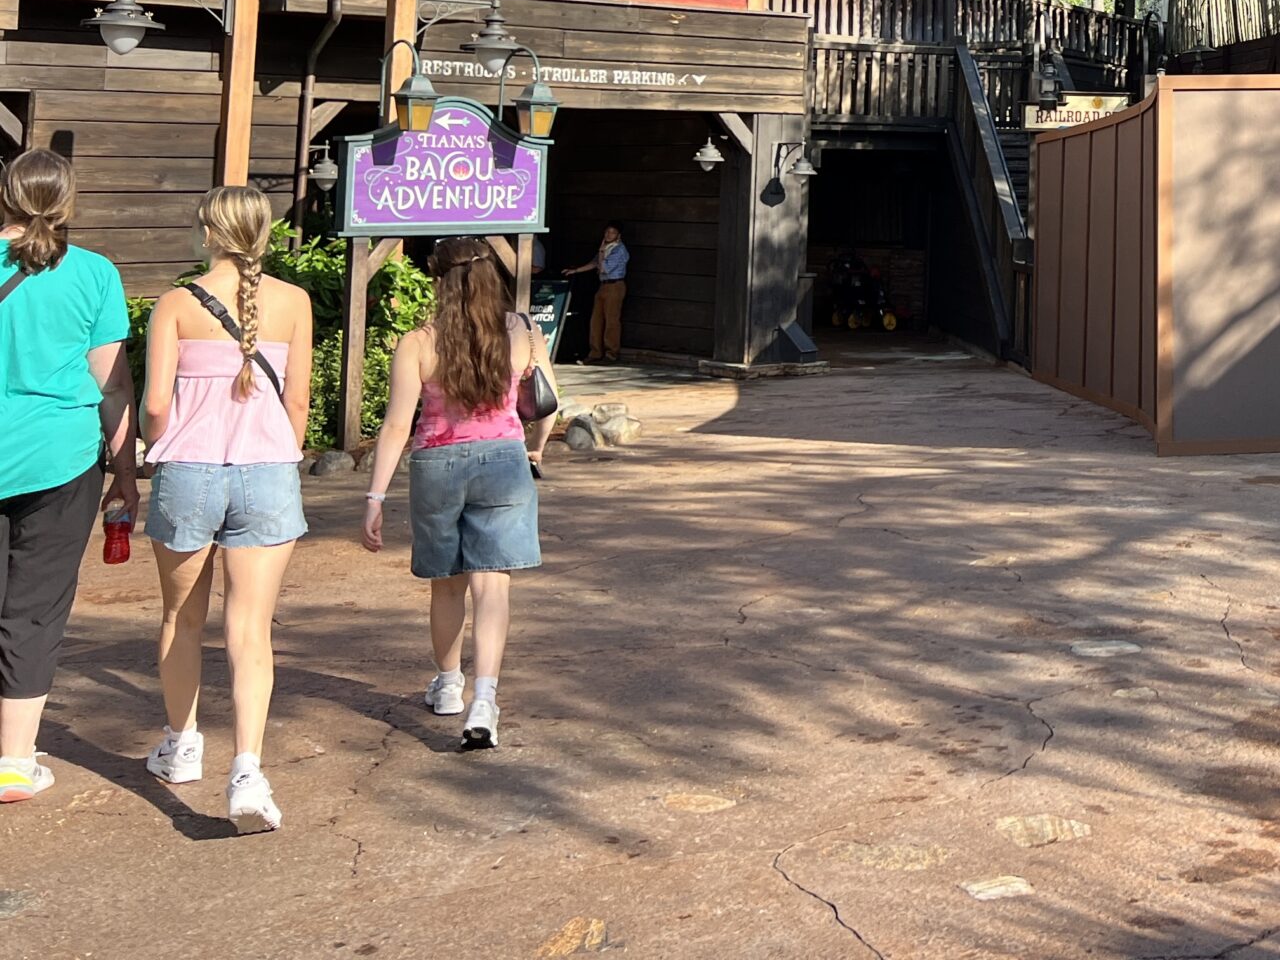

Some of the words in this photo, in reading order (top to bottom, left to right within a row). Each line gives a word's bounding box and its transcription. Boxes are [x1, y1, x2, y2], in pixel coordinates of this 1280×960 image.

[422, 59, 516, 79] RESTROS
[612, 70, 675, 85] PARKING
[1035, 109, 1100, 124] RAILROAD
[417, 133, 485, 149] TIANA'S
[405, 152, 493, 181] BAYOU
[376, 183, 518, 216] ADVENTURE
